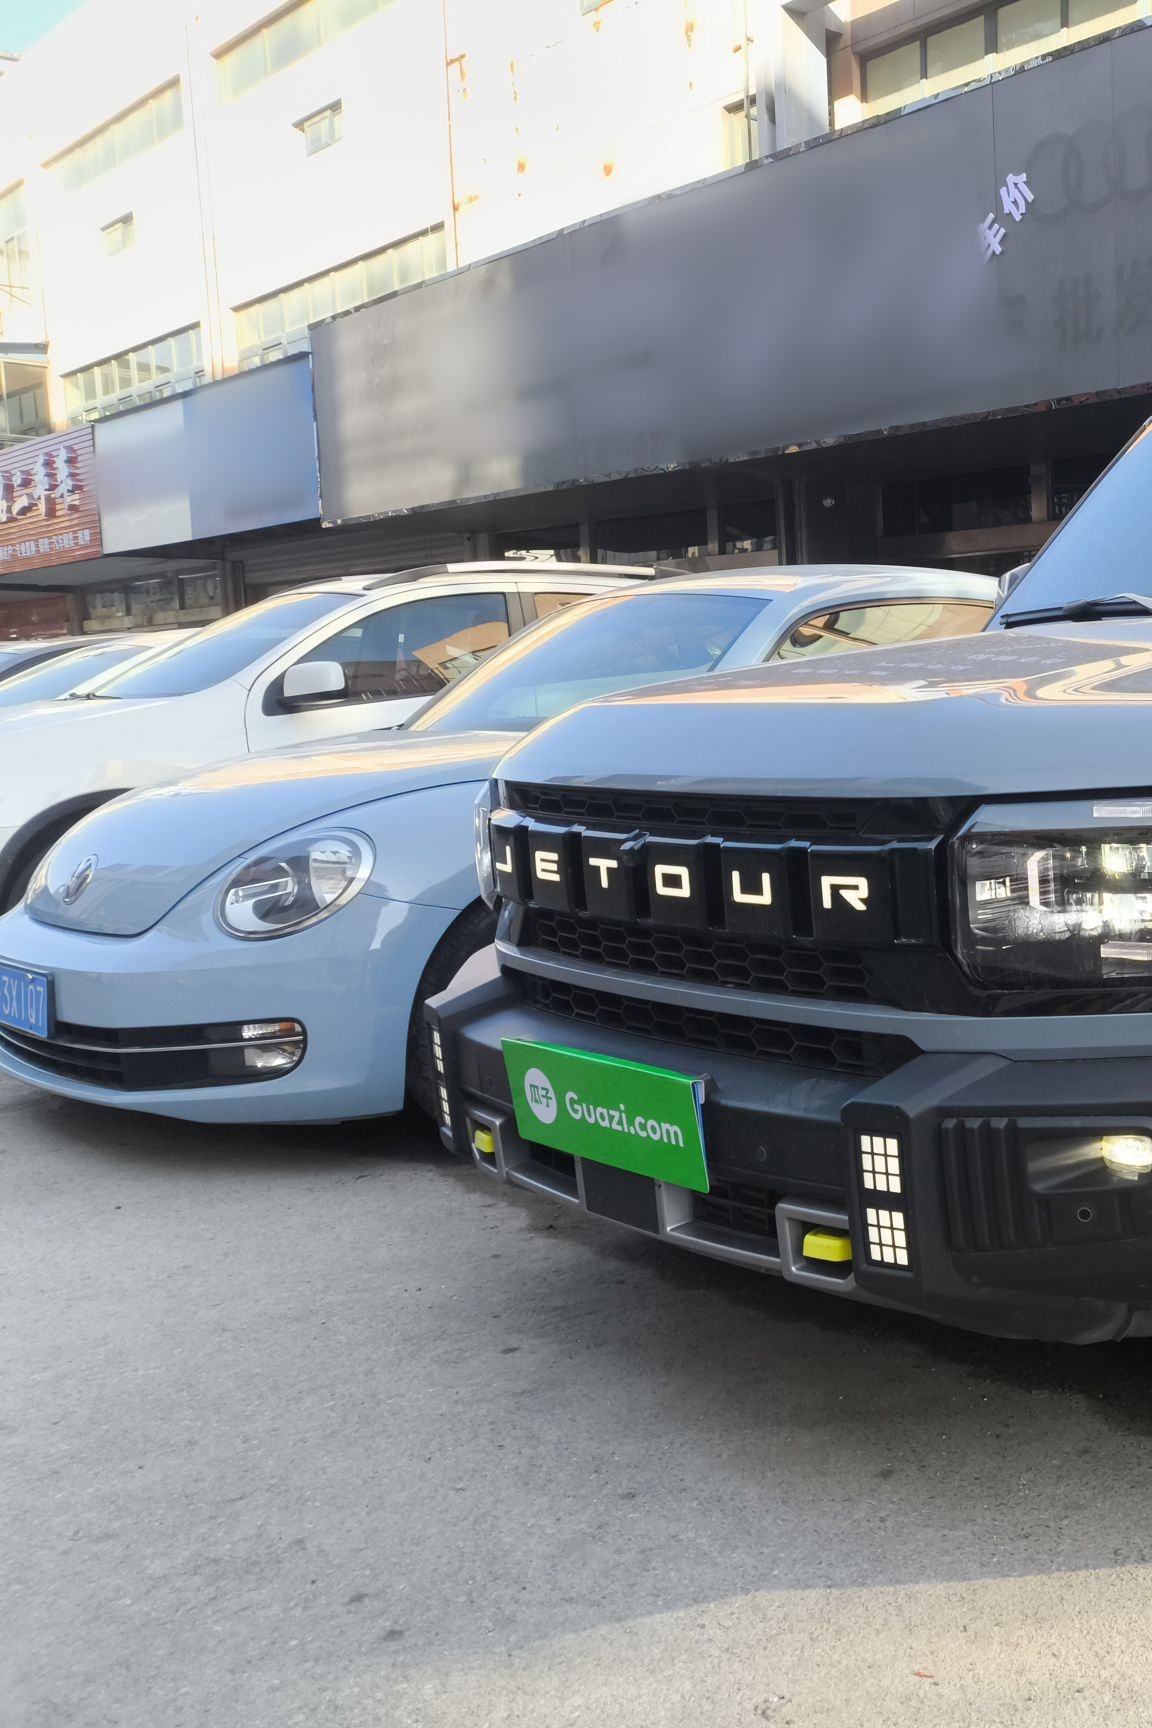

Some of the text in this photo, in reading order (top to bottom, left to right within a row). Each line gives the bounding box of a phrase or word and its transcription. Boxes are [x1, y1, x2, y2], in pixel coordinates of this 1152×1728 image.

[495, 845, 869, 911] JETOUR
[529, 1083, 552, 1108] 瓜子
[565, 1090, 684, 1148] Guazi.com
